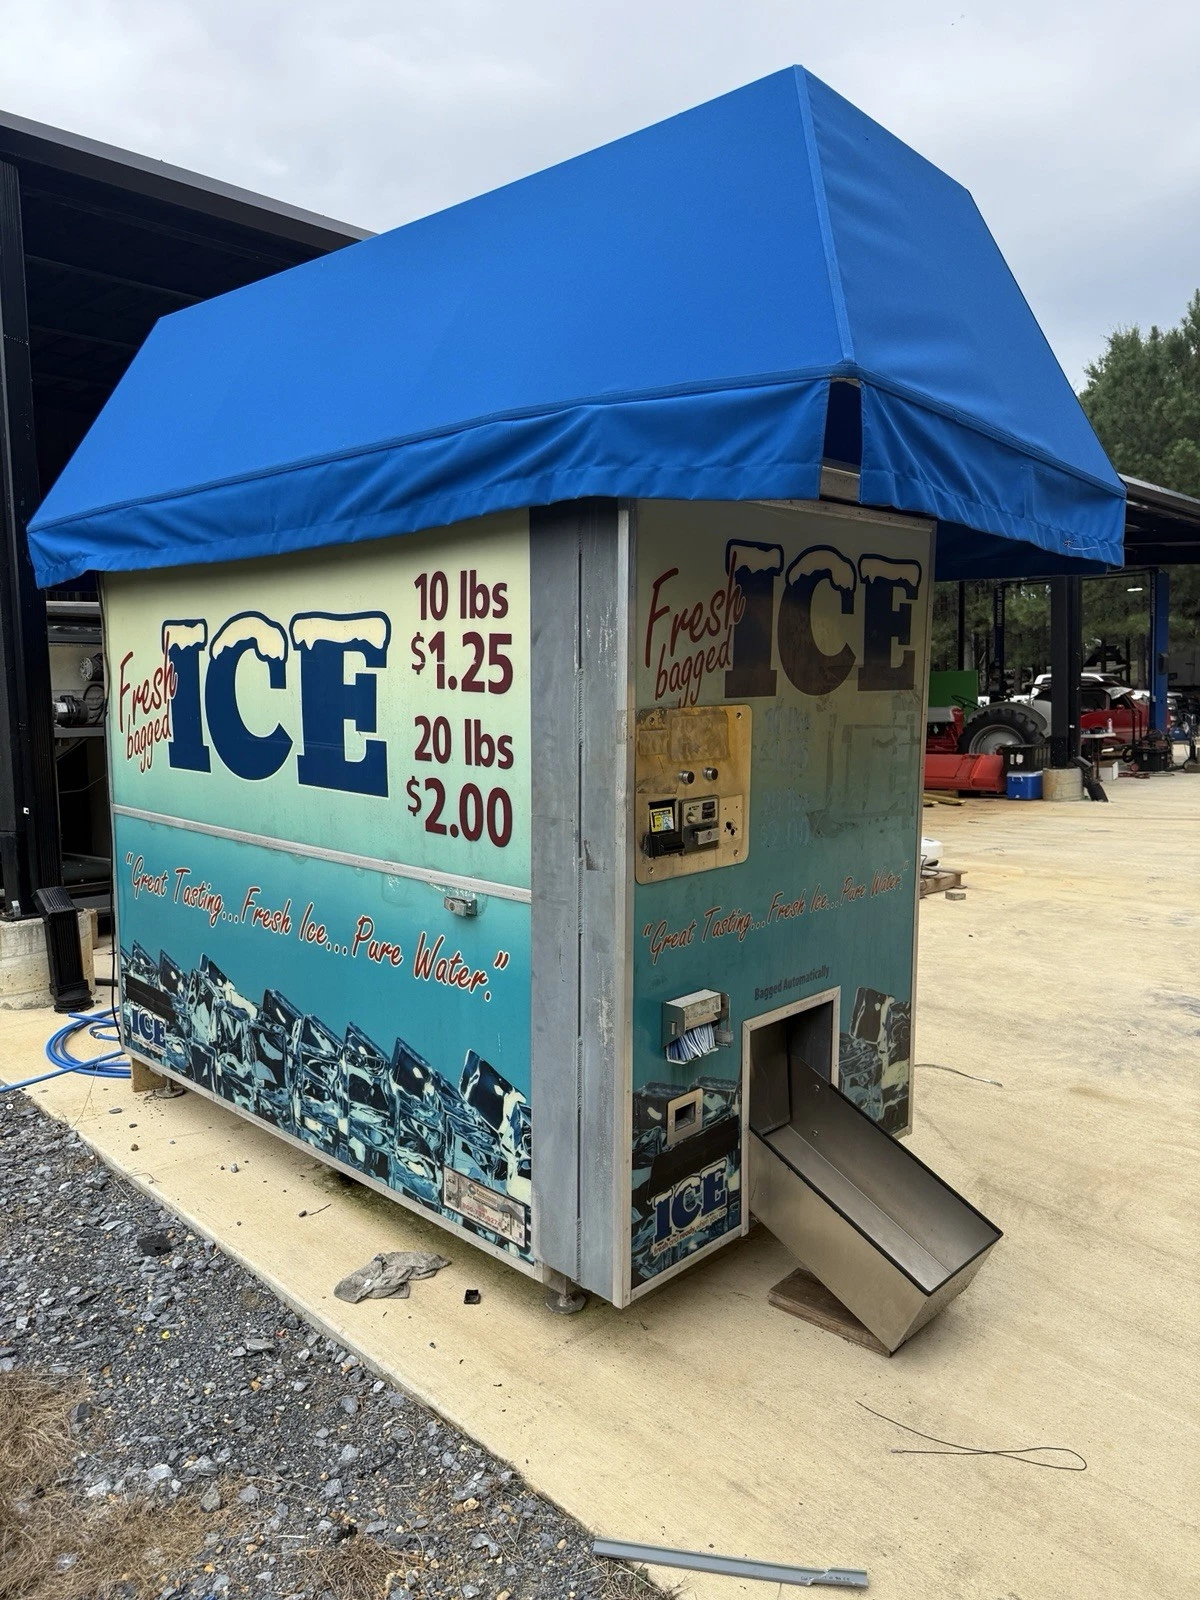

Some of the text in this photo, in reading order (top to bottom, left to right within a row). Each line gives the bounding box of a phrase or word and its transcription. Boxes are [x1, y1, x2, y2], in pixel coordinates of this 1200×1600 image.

[414, 570, 509, 620] 10 lbs
[645, 550, 746, 668] Fresh
[724, 538, 922, 698] ICE
[119, 631, 178, 734] Fresh
[411, 631, 514, 695] $1.25
[655, 624, 732, 709] bagged
[126, 703, 173, 774] bagged
[162, 610, 391, 798] ICE
[414, 716, 515, 770] 20 lbs
[406, 776, 513, 848] $2.00
[754, 964, 830, 1000] Bagged Automatically
[131, 1003, 167, 1049] ICE
[653, 1157, 728, 1243] ICE
